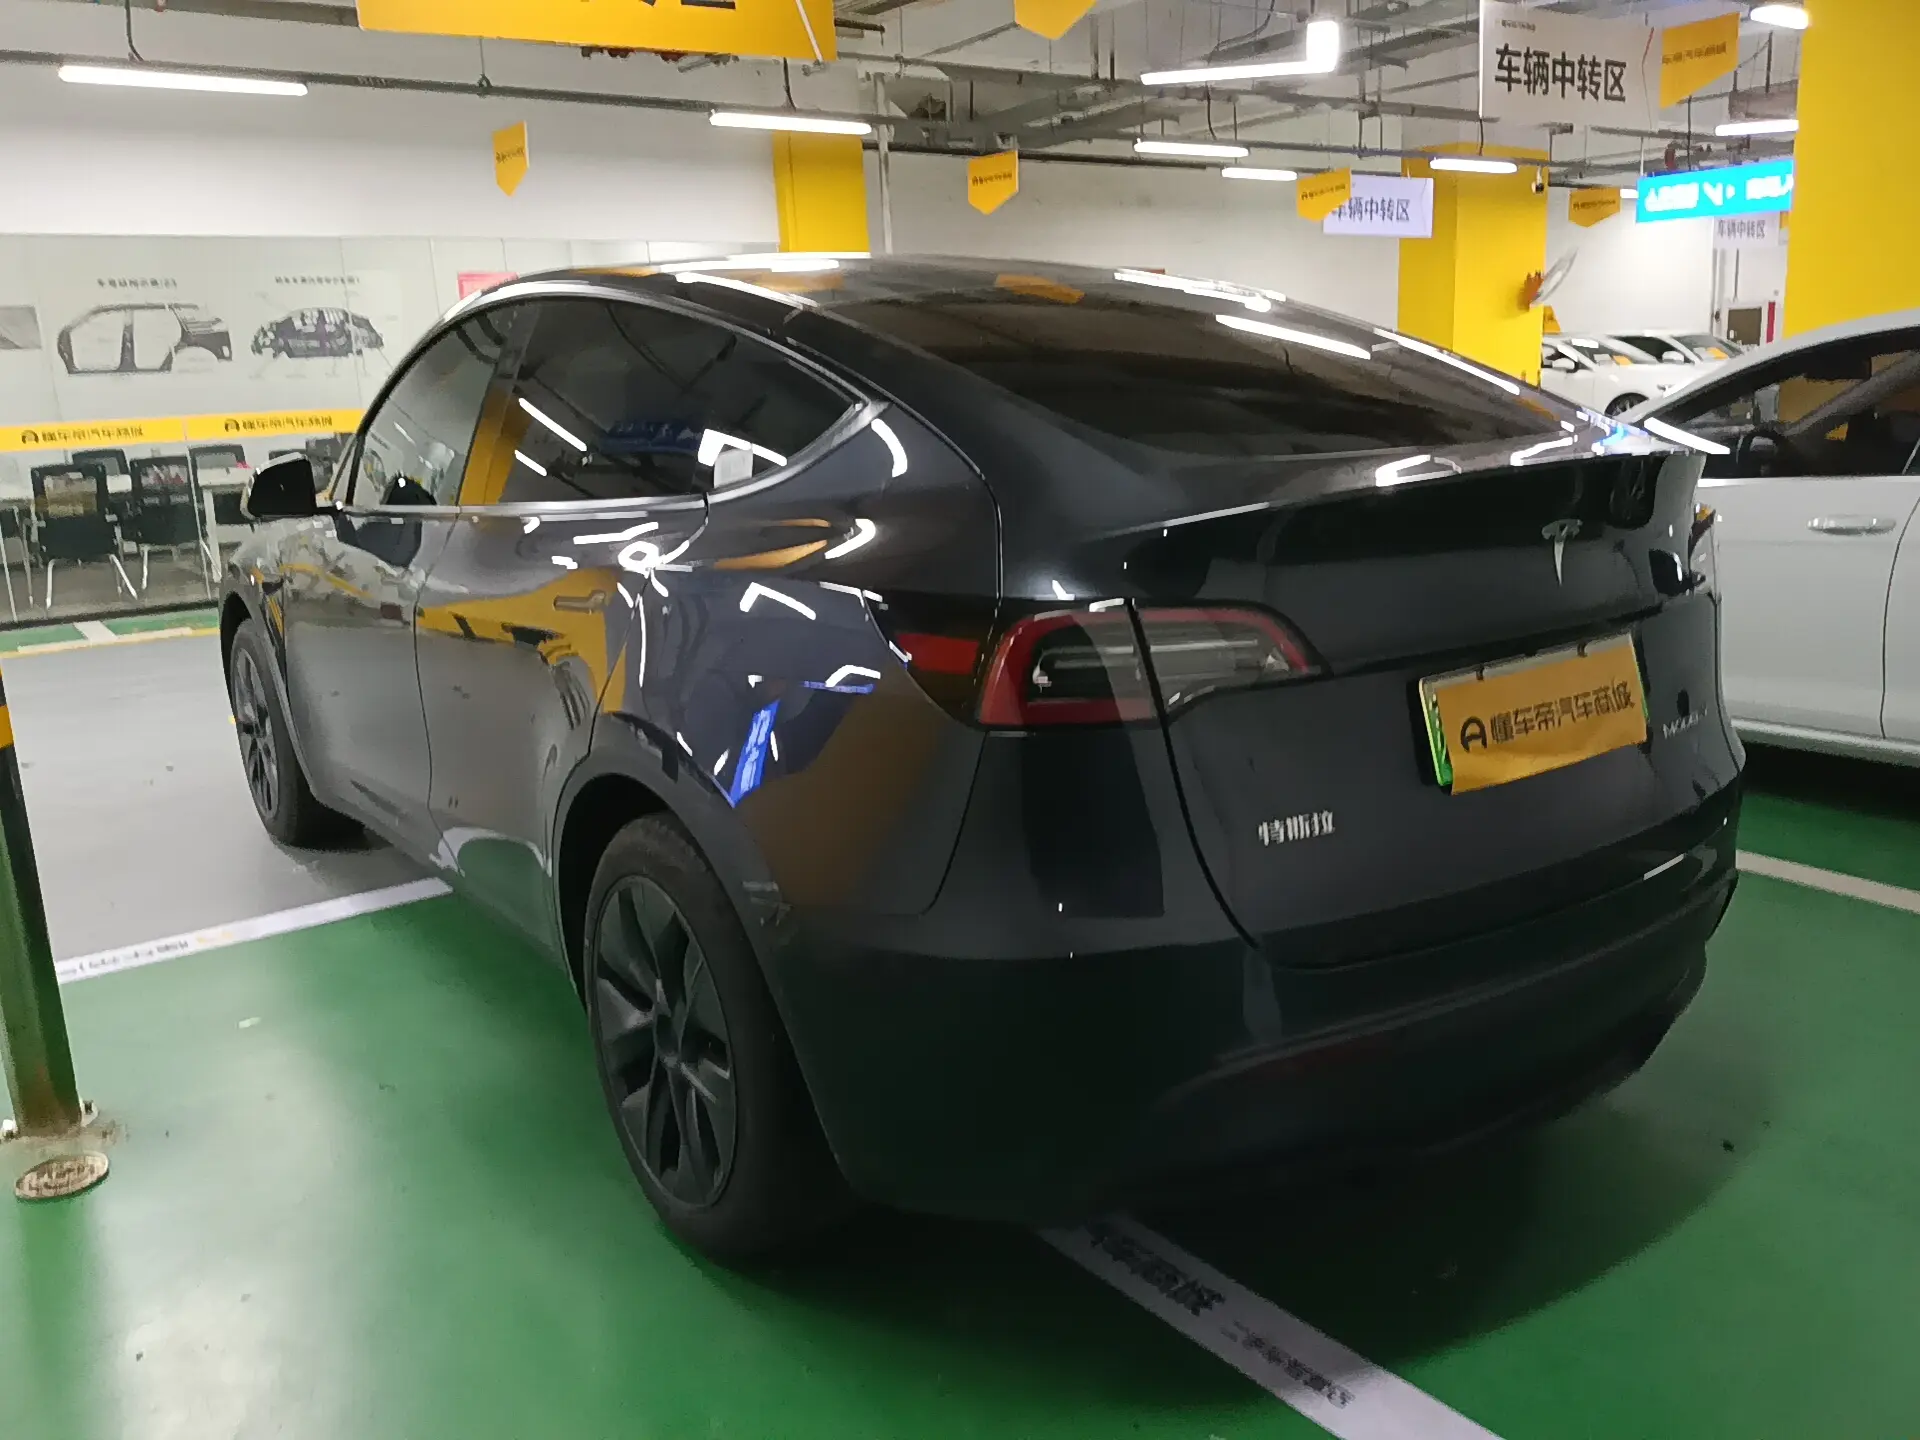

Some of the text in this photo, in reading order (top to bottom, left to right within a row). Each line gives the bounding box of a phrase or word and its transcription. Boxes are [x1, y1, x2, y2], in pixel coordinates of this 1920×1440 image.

[1494, 43, 1627, 102] 车辆中转区
[1490, 676, 1636, 744] 懂车帝汽车商城
[1258, 809, 1336, 847] 特斯拉
